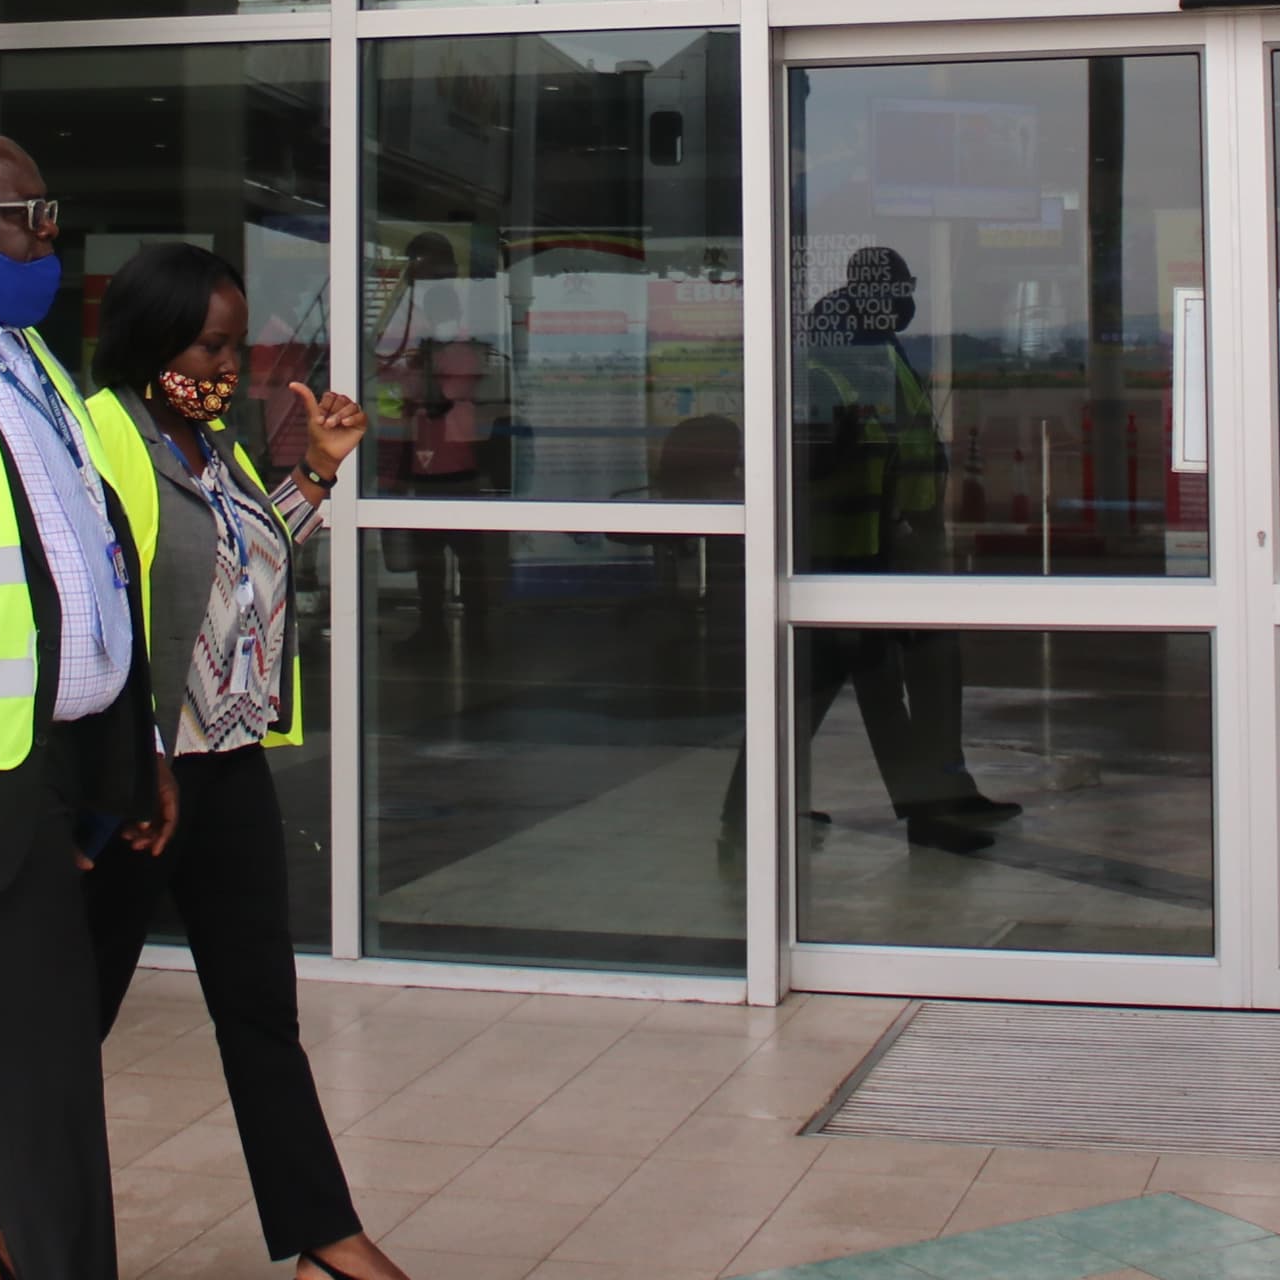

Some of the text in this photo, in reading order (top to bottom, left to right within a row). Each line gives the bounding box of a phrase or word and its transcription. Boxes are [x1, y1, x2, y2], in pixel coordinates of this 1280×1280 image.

[794, 282, 914, 298] NOW-CAPPED
[822, 298, 850, 315] DO
[855, 298, 893, 315] YOU
[793, 314, 899, 331] NJOY A HOT
[794, 331, 855, 348] AUNA?
